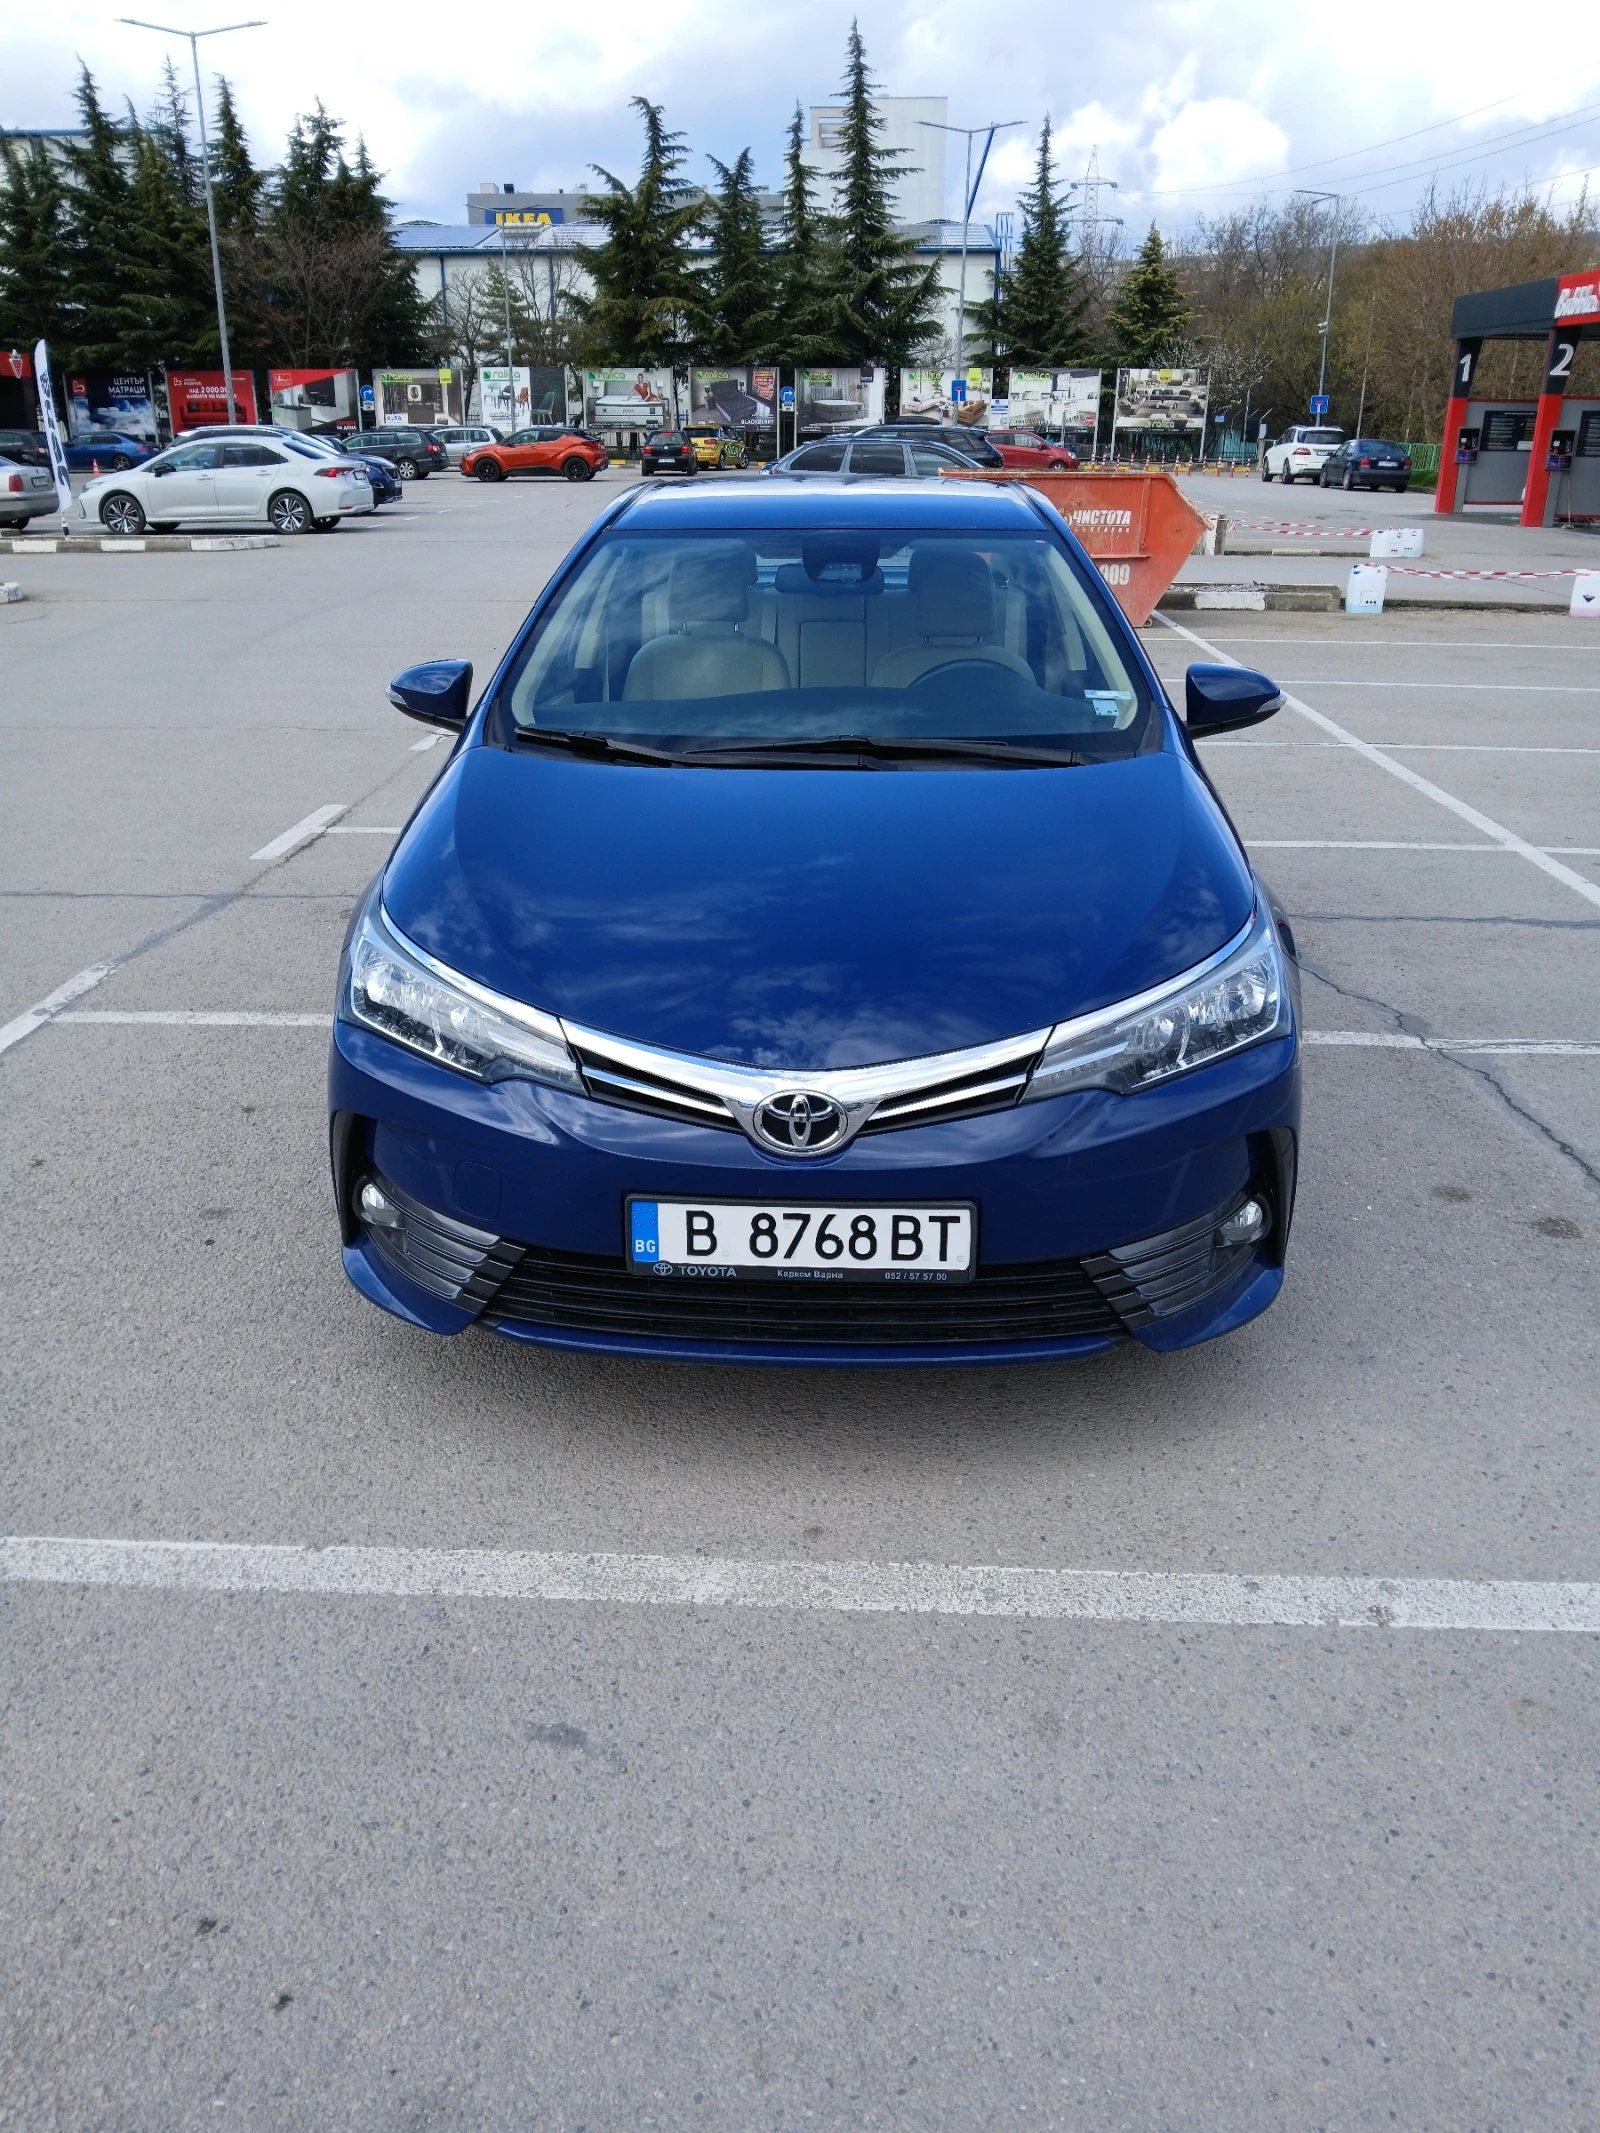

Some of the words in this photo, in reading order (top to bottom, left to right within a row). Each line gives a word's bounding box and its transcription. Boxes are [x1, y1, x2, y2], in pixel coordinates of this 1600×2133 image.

[495, 212, 552, 225] IKEA
[1550, 343, 1574, 376] 2
[1460, 353, 1471, 381] 1
[493, 368, 520, 378] ralia
[704, 370, 728, 379] ralica
[810, 371, 834, 380] ralica
[113, 377, 145, 386] ЦЕНТЪР
[107, 386, 146, 394] МАТРАЦИ
[1151, 419, 1175, 428] ralica
[1073, 509, 1132, 525] ЧИСТОТА
[685, 1209, 718, 1257] B
[749, 1212, 878, 1261] 8768
[890, 1214, 961, 1263] BT
[634, 1239, 656, 1254] BG
[677, 1264, 738, 1278] TOYOTA
[776, 1269, 811, 1280] Карком
[812, 1269, 844, 1280] Варна
[884, 1272, 900, 1280] 052
[908, 1272, 921, 1281] 57
[922, 1272, 934, 1281] 57
[935, 1273, 948, 1282] 00
